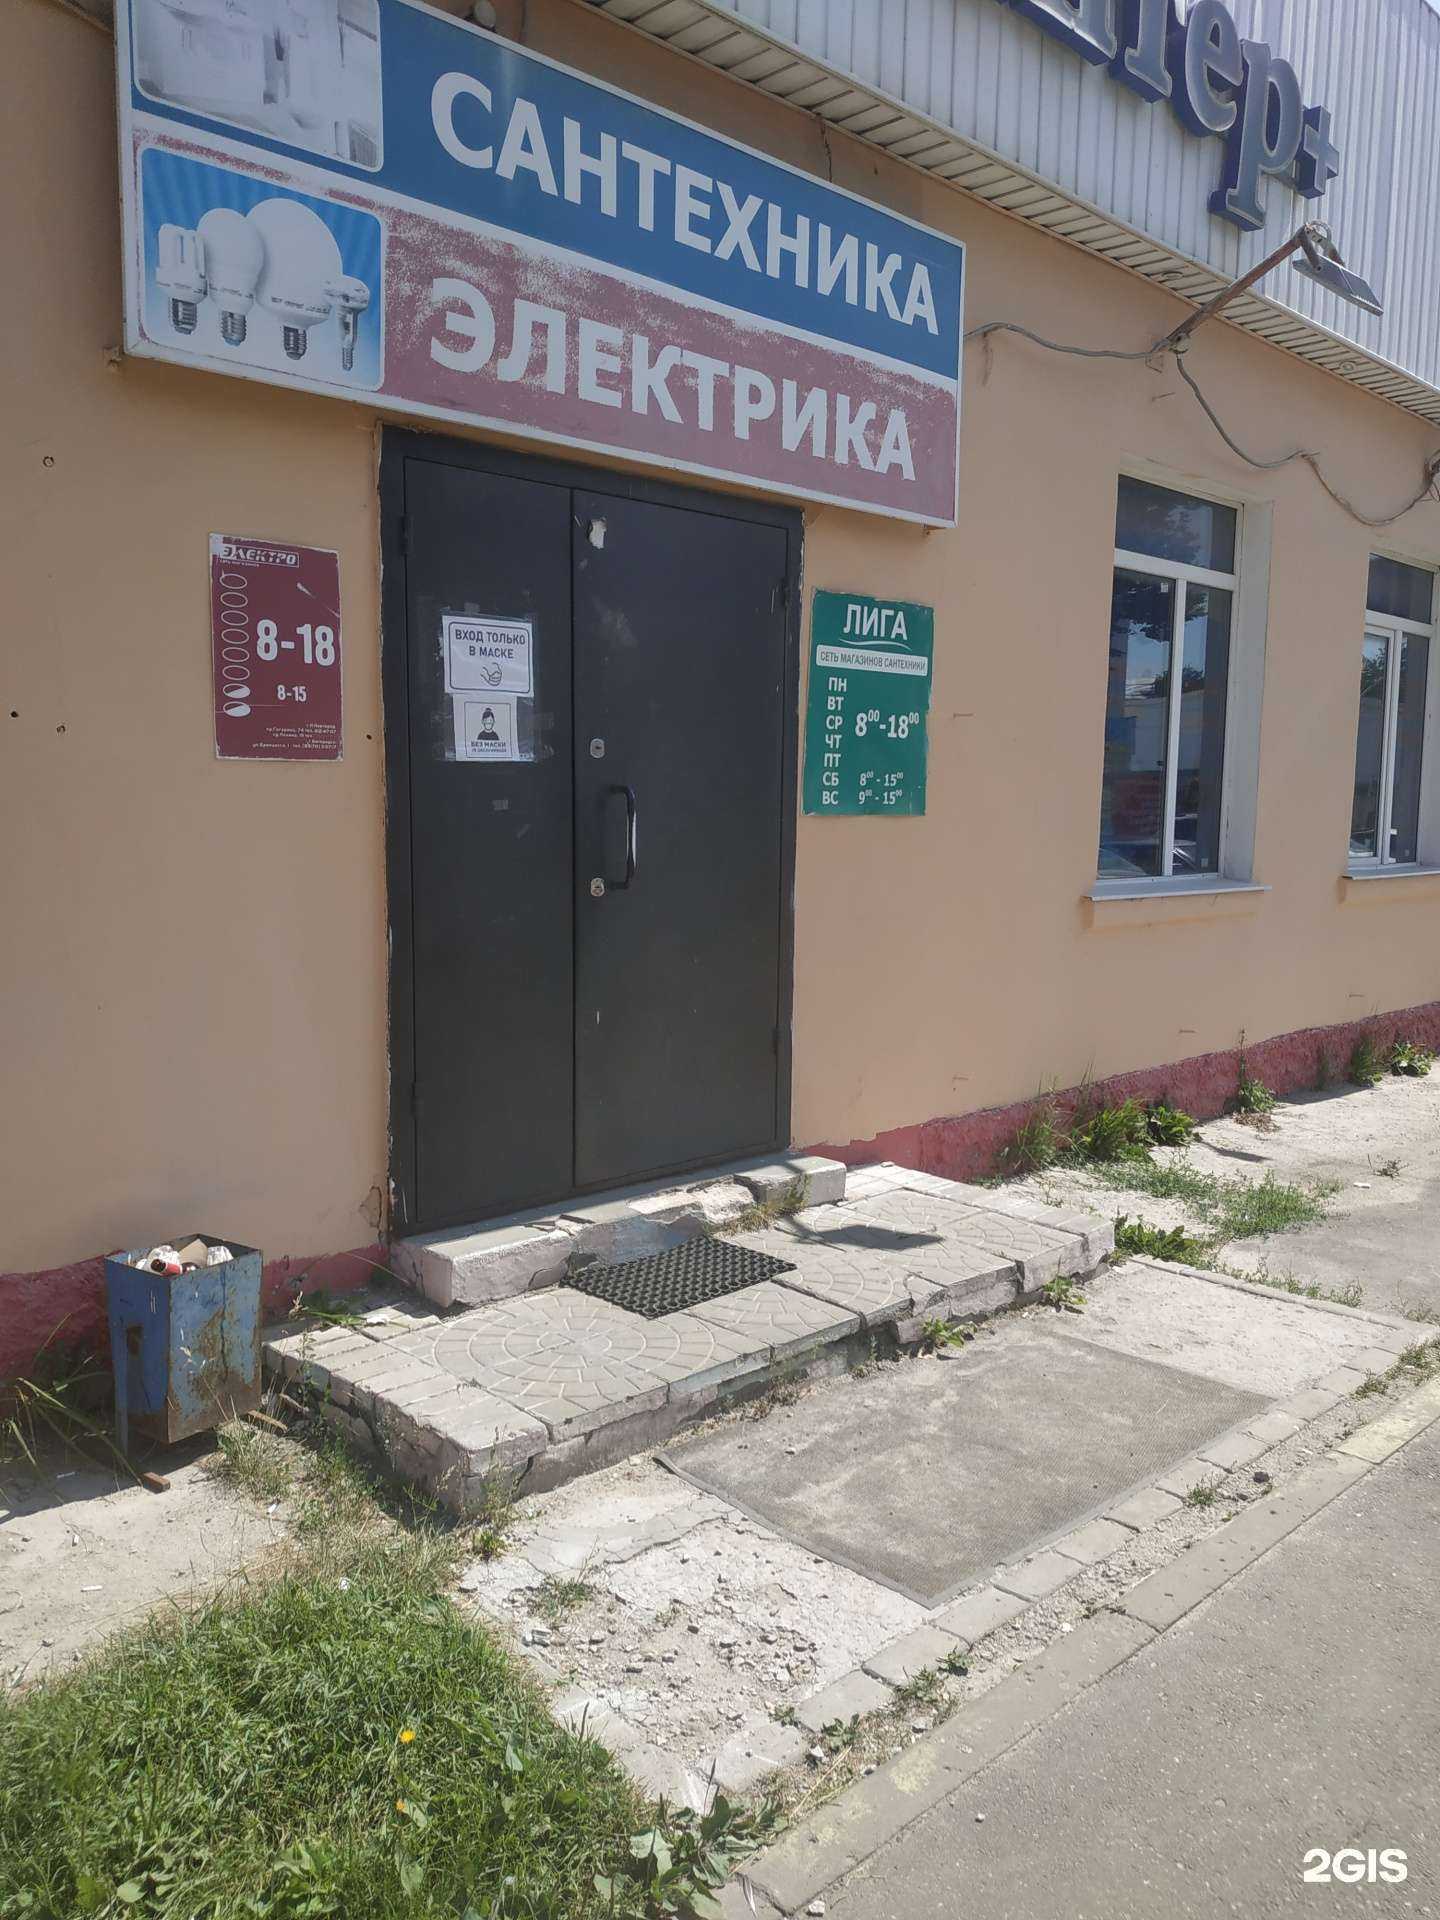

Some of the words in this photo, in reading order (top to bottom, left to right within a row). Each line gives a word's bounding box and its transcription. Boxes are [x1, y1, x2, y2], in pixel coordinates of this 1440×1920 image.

[430, 71, 941, 336] САНТЕХНИКА
[430, 276, 917, 483] ЭЛЕКТРИКА
[843, 603, 908, 641] ЛИГА
[256, 619, 336, 667] 8-18
[455, 629, 484, 643] ВХОД
[486, 631, 526, 645] ТОЛЬКО
[469, 645, 476, 656] В
[480, 646, 514, 659] МАСКЕ
[820, 651, 839, 662] СЕТЬ
[840, 653, 883, 668] МАГАЗИНОВ
[884, 657, 926, 671] САНТЕХНИКИ
[828, 677, 847, 692] ПН
[277, 684, 307, 702] 8-15
[827, 696, 844, 711] ВТ
[826, 715, 843, 730] СР
[825, 734, 842, 749] ЧТ
[824, 752, 842, 768] ПТ
[822, 771, 839, 786] СБ
[822, 790, 839, 805] ВС
